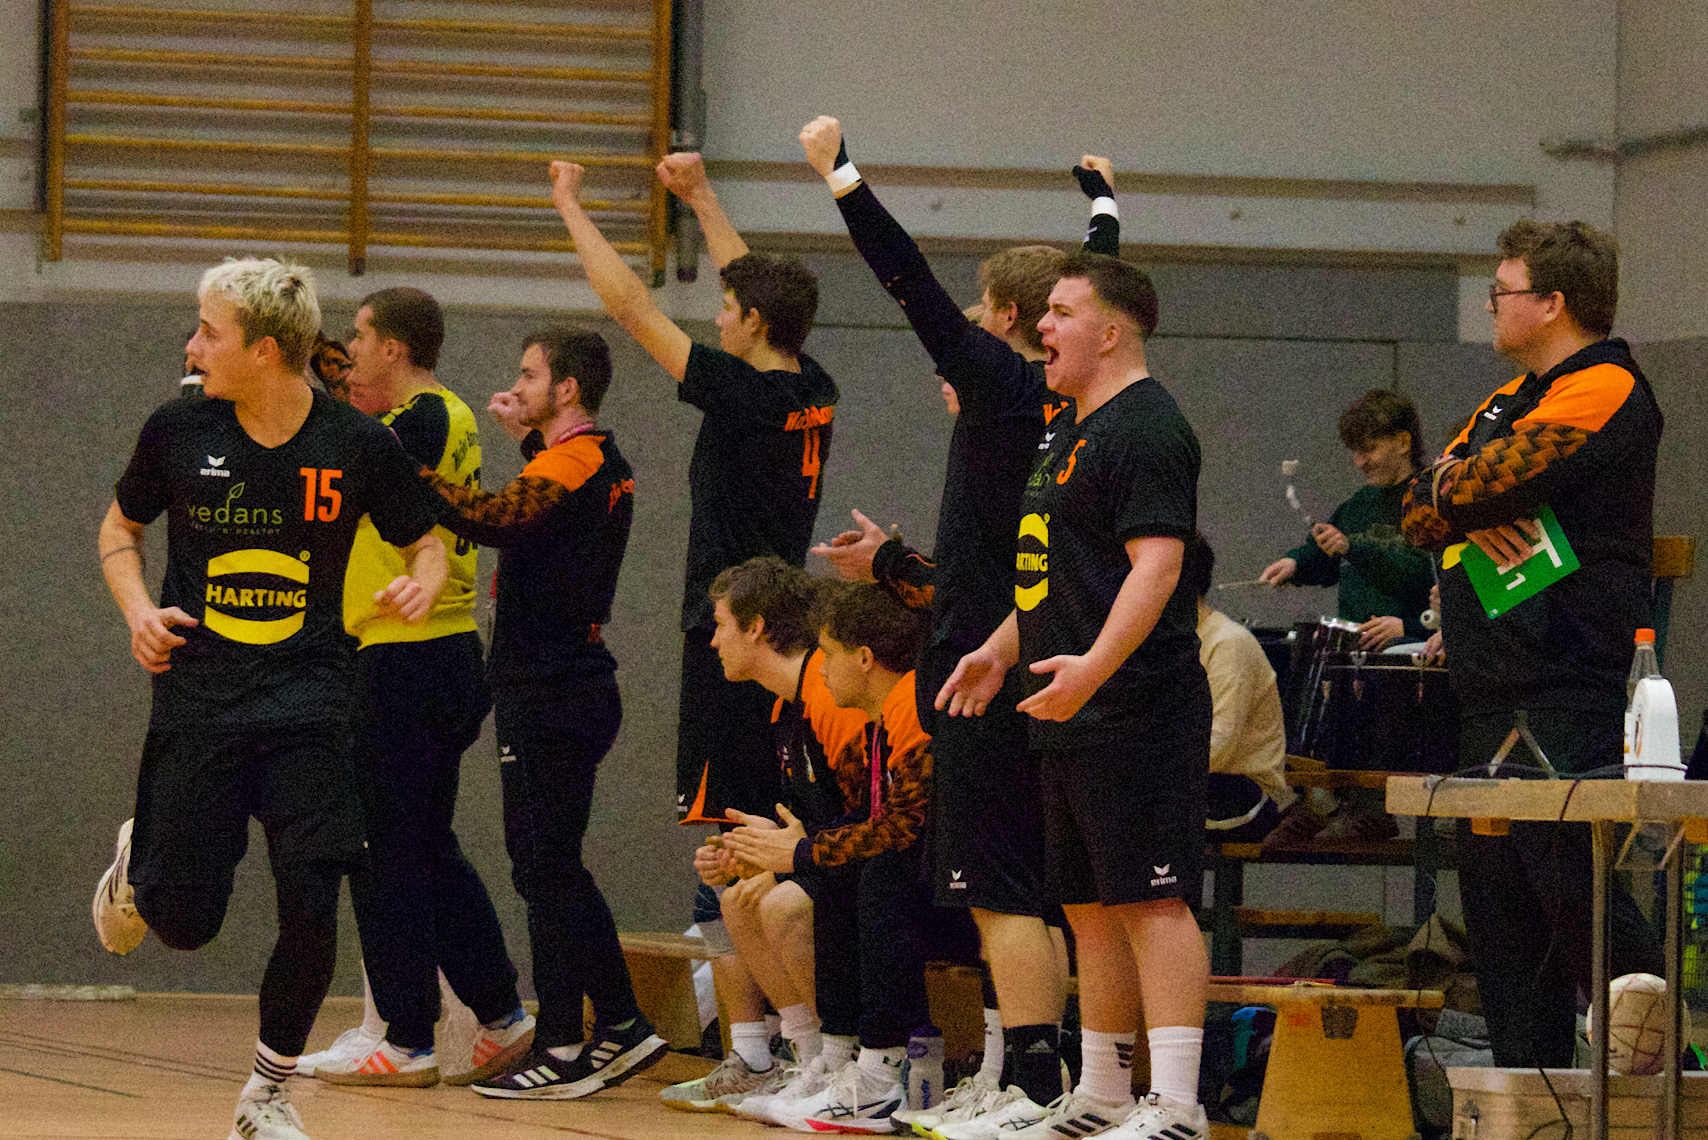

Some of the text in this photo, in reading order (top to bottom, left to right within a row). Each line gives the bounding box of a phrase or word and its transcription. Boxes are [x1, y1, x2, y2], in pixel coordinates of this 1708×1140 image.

[187, 489, 283, 525] vedans
[300, 467, 343, 523] 15
[205, 583, 307, 608] HARTING
[1150, 875, 1178, 888] erima
